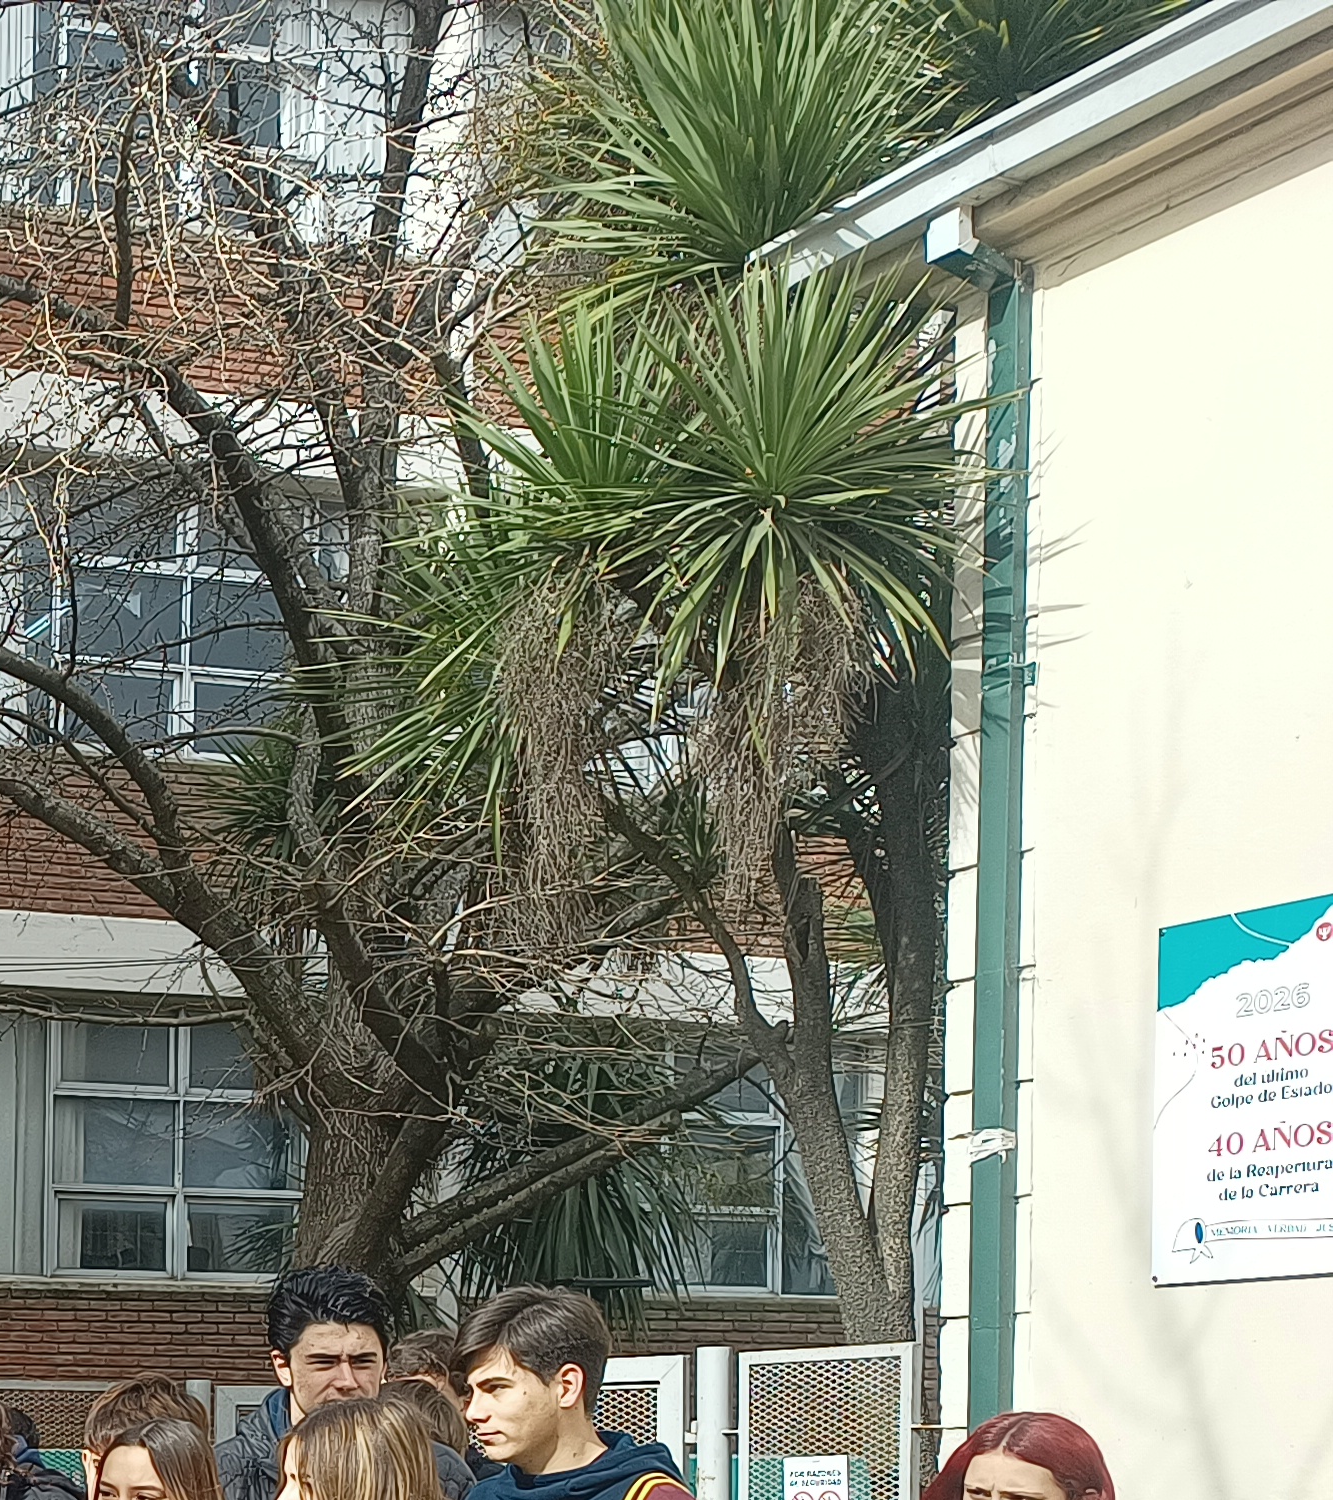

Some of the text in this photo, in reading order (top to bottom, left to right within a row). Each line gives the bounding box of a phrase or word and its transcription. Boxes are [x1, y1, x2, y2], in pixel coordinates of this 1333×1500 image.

[1235, 982, 1311, 1018] 2026
[1210, 1029, 1333, 1069] 50 AÑOS
[1234, 1072, 1257, 1087] del
[1211, 1082, 1333, 1109] Golpe de Estado
[1207, 1121, 1333, 1157] 40 AÑOS
[1206, 1159, 1333, 1182] de la Reapertura
[1218, 1187, 1237, 1201] de
[1258, 1181, 1320, 1198] Carrera
